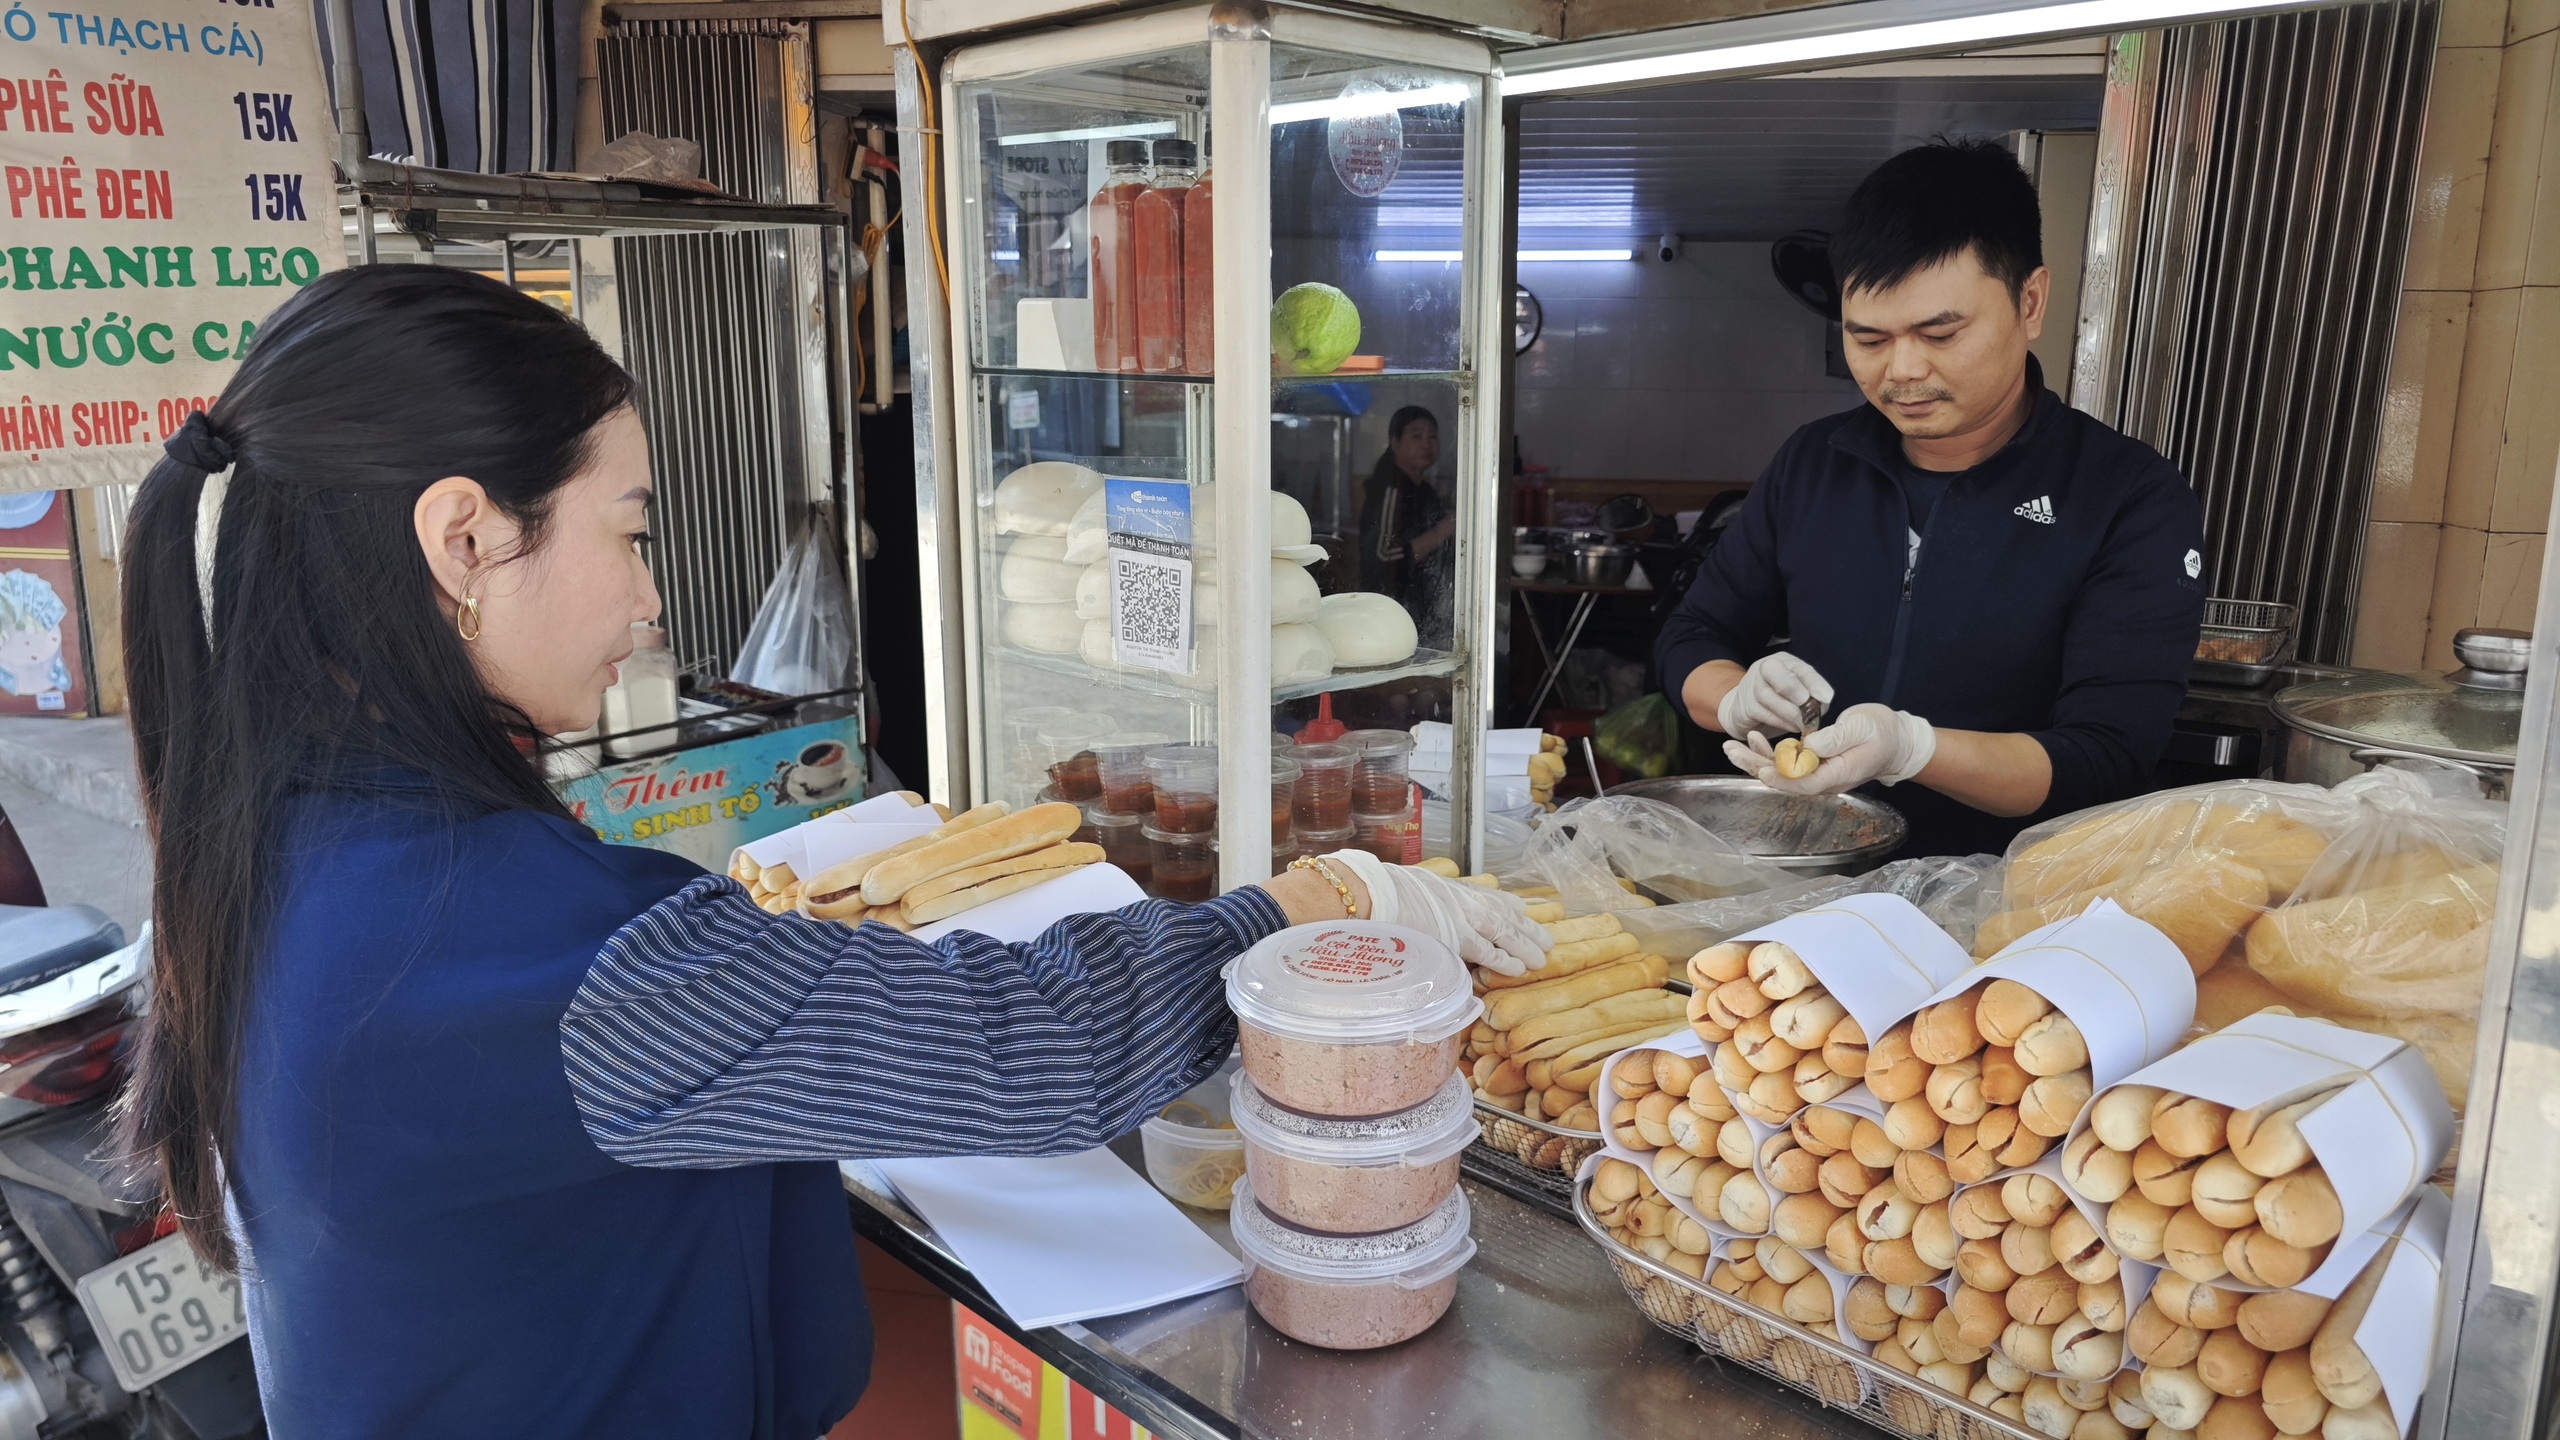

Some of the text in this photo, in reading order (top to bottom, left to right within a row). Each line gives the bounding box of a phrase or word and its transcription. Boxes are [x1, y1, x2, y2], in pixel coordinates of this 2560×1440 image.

[47, 11, 190, 56] THẠCH
[200, 21, 264, 66] CÁ)
[0, 68, 299, 143] PHÊ SỮA 15K
[4, 156, 308, 222] PHÊ ĐEN 15K
[0, 246, 320, 291] HANH LEO
[0, 311, 175, 371] NƯỚC
[72, 400, 151, 447] SHIP:
[2013, 505, 2057, 525] adidas
[1125, 536, 1137, 547] MÃ
[1147, 541, 1170, 553] THANH
[605, 769, 728, 811] Thêm
[633, 782, 761, 841] SINH TỐ
[1299, 945, 1405, 968] Hậu Hương
[1327, 940, 1388, 954] Cột Đèn
[1347, 935, 1381, 944] PATE
[990, 1355, 1032, 1399] Food
